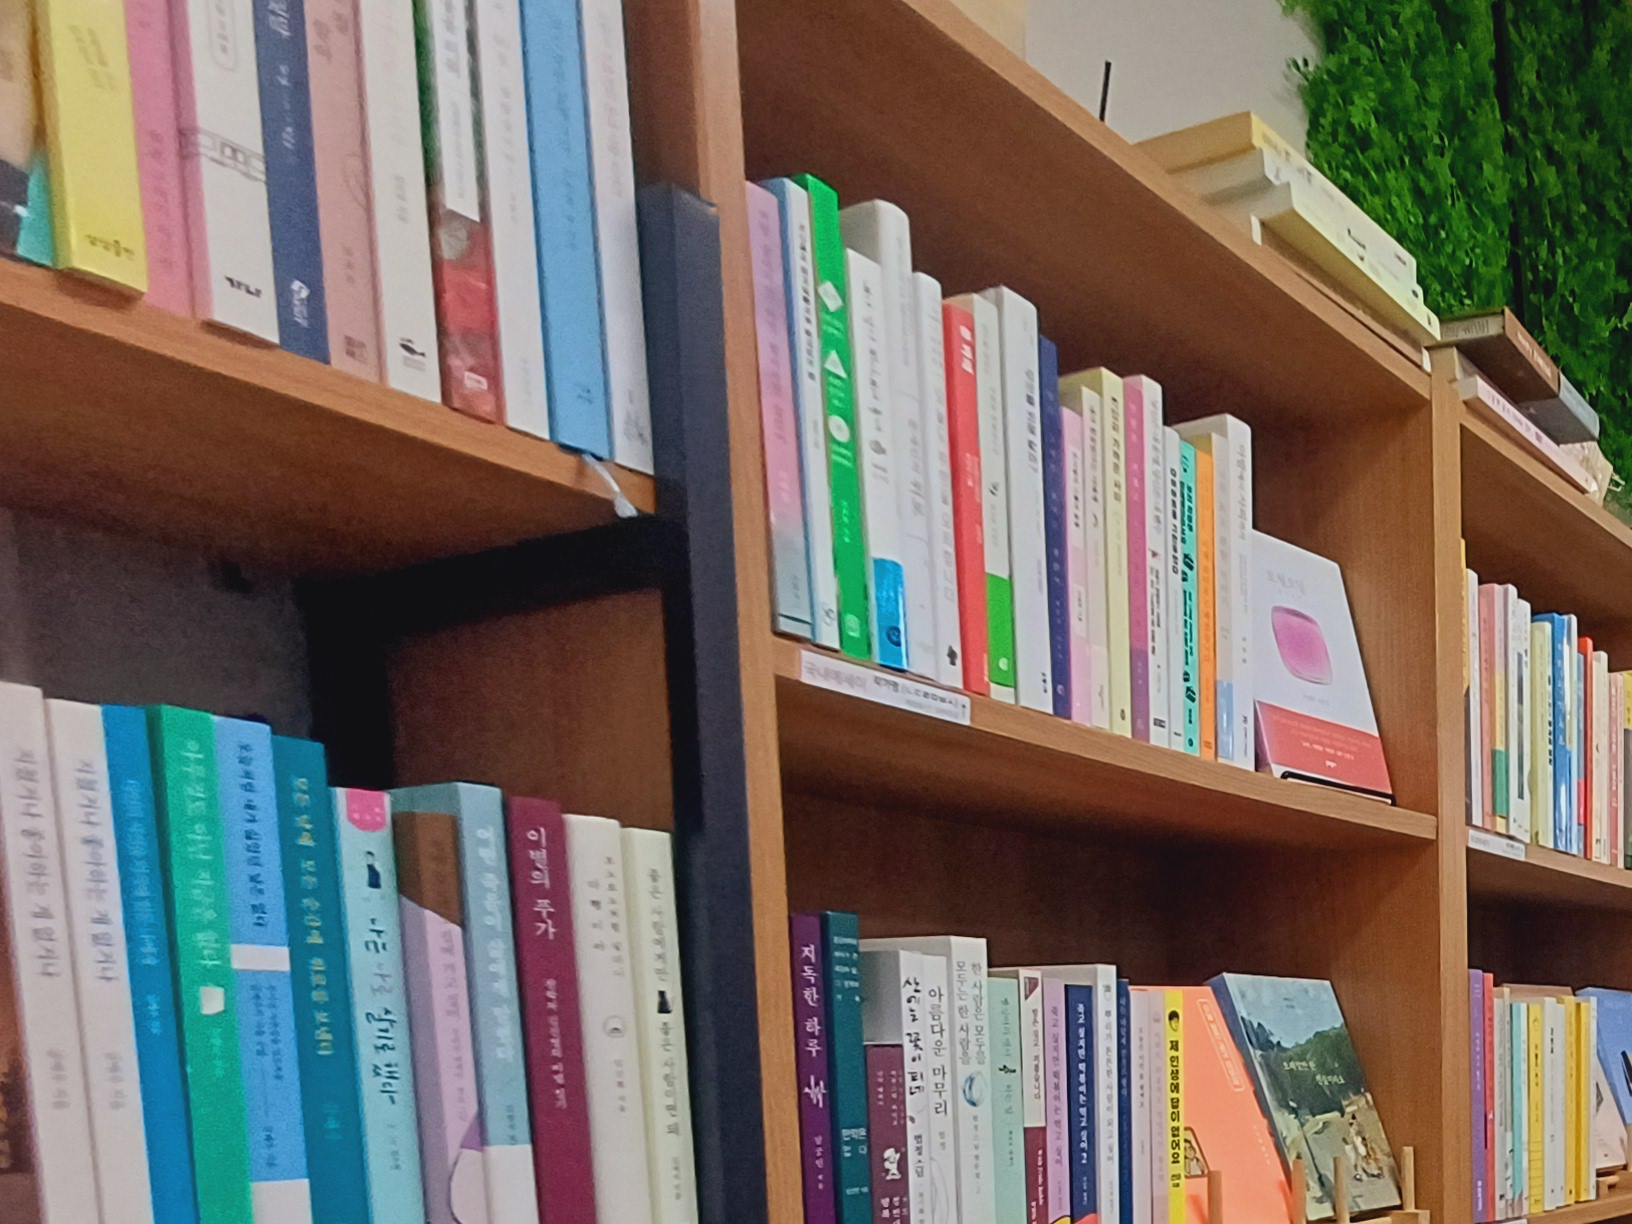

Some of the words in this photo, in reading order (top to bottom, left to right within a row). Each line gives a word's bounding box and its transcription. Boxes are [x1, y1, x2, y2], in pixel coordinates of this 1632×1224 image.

[526, 826, 550, 889] 이별의
[532, 898, 556, 941] 푸가
[801, 943, 820, 1008] 지독한
[902, 976, 922, 1023] 산에는
[927, 985, 949, 1057] 아름다운
[366, 1007, 398, 1053] 살기로
[804, 1016, 821, 1058] 하루
[905, 1031, 924, 1063] 꽃이
[1169, 1039, 1180, 1053] 제
[371, 1061, 400, 1106] 했다
[907, 1070, 925, 1096] 피네
[932, 1066, 949, 1116] 마무리
[1169, 1055, 1181, 1095] 인생에
[1170, 1096, 1181, 1124] 답이
[1170, 1126, 1182, 1165] 없어요
